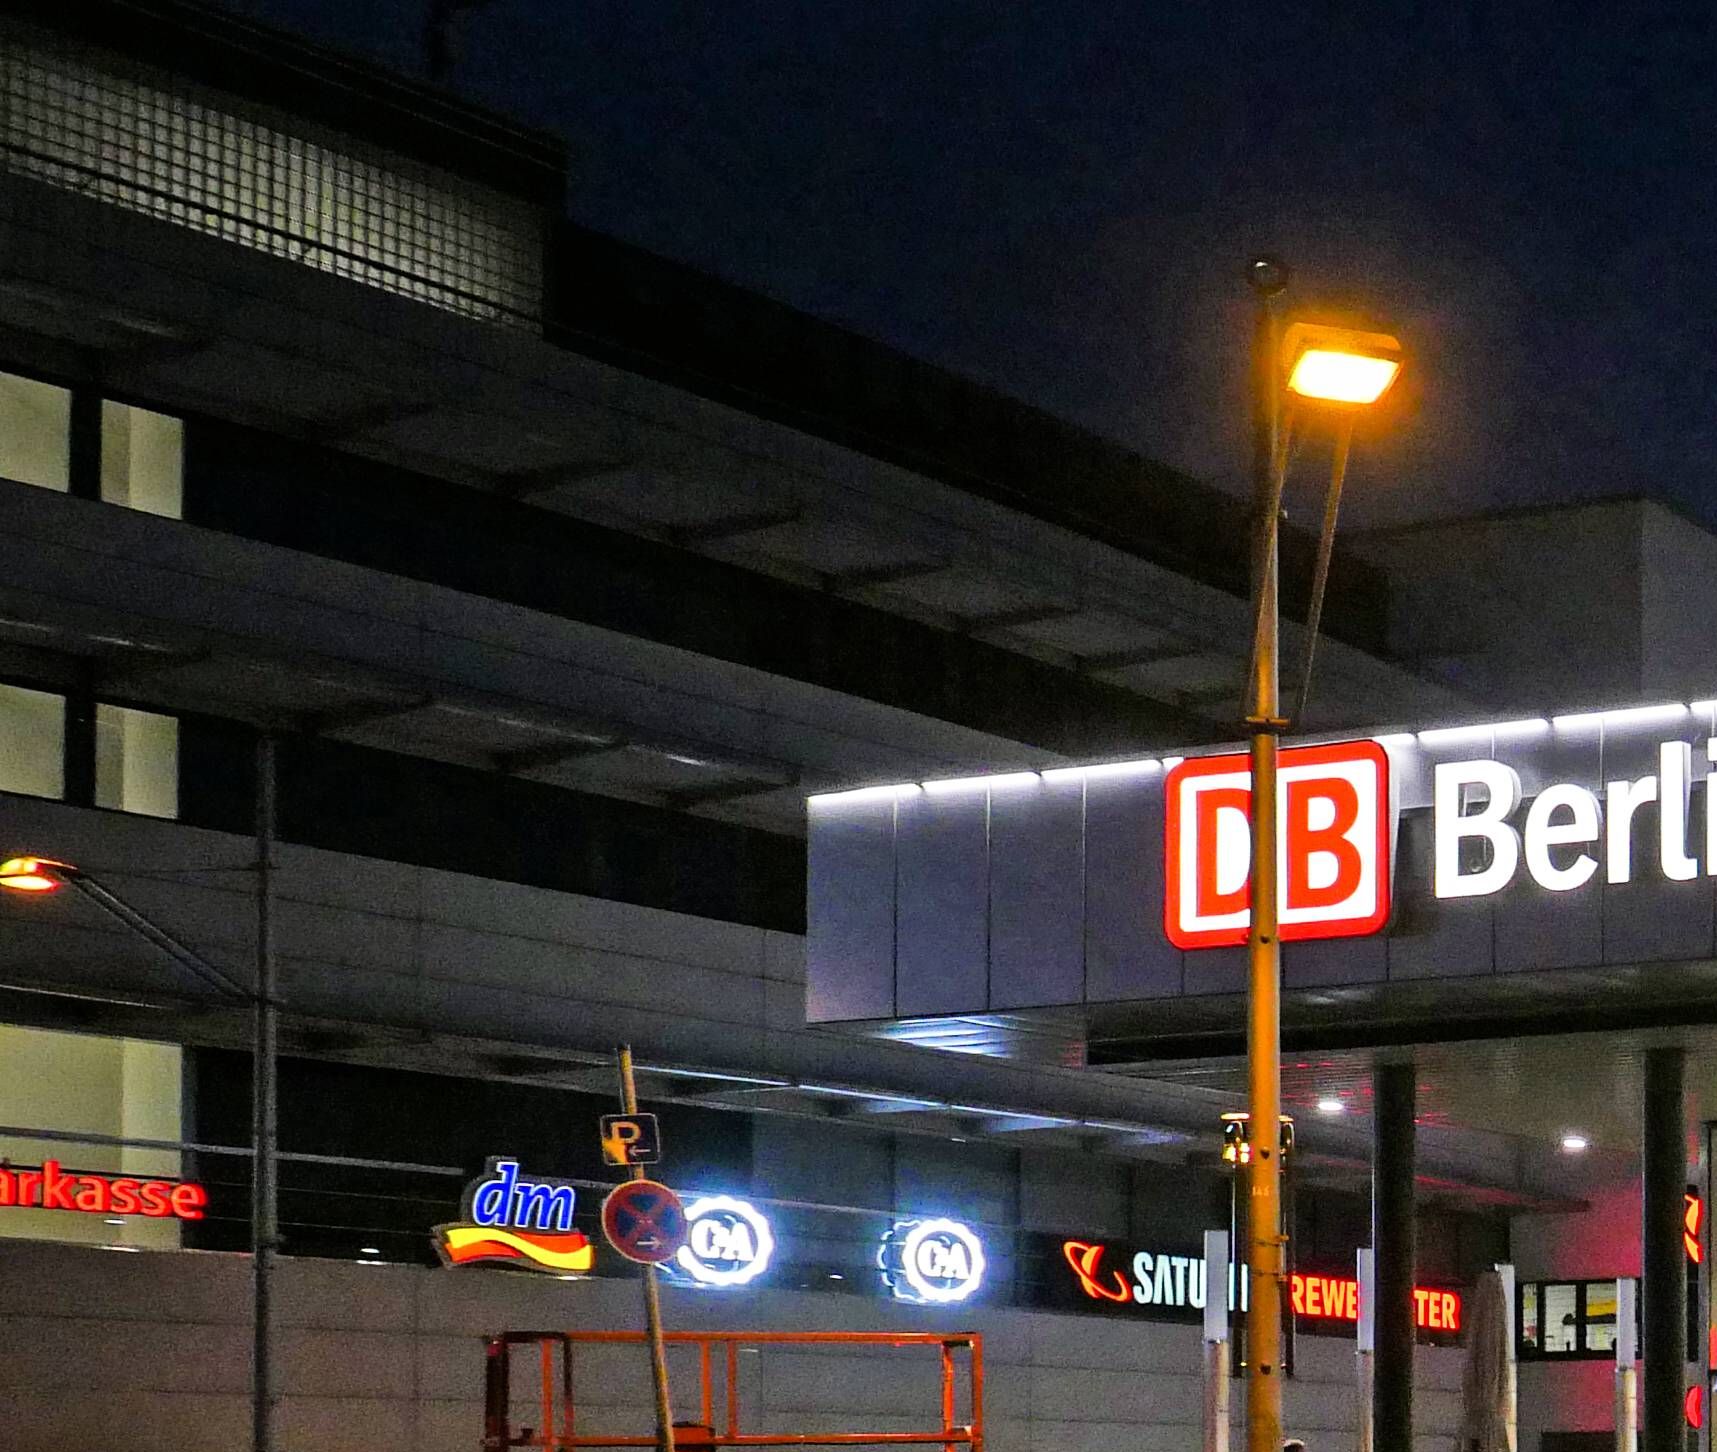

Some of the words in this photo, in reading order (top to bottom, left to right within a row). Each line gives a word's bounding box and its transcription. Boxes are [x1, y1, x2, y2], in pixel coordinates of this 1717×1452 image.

[1195, 773, 1364, 919] DB
[472, 1161, 577, 1231] dm
[1133, 1250, 1249, 1313] SATU
